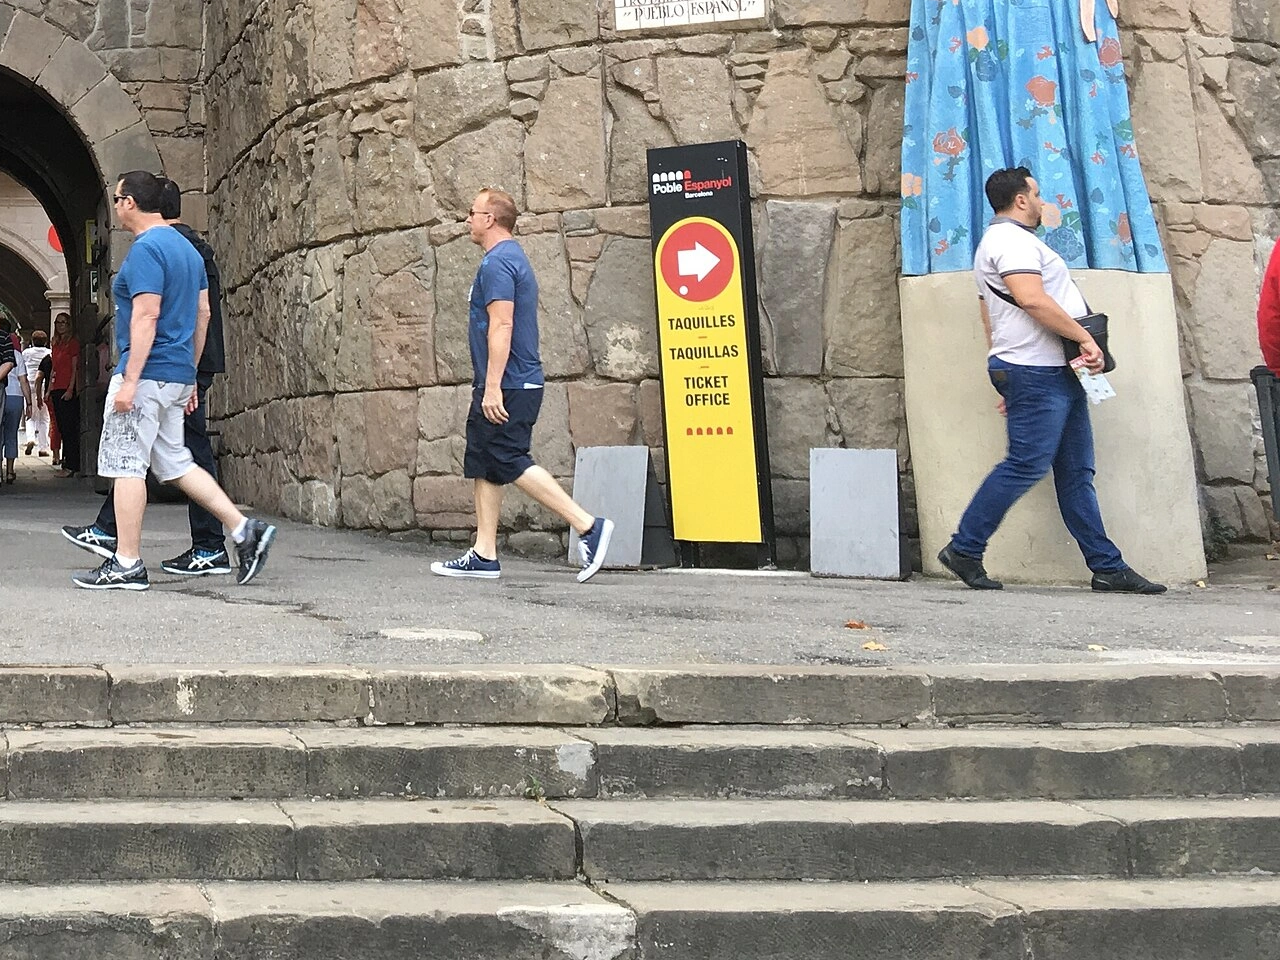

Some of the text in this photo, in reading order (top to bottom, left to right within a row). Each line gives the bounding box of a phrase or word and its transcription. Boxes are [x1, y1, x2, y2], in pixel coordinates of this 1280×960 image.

[653, 176, 732, 194] Poble Espanyol
[668, 315, 735, 330] TAQUILLES
[669, 345, 738, 360] TAQUILLAS
[684, 376, 728, 389] TICKET
[686, 393, 730, 406] OFFICE
